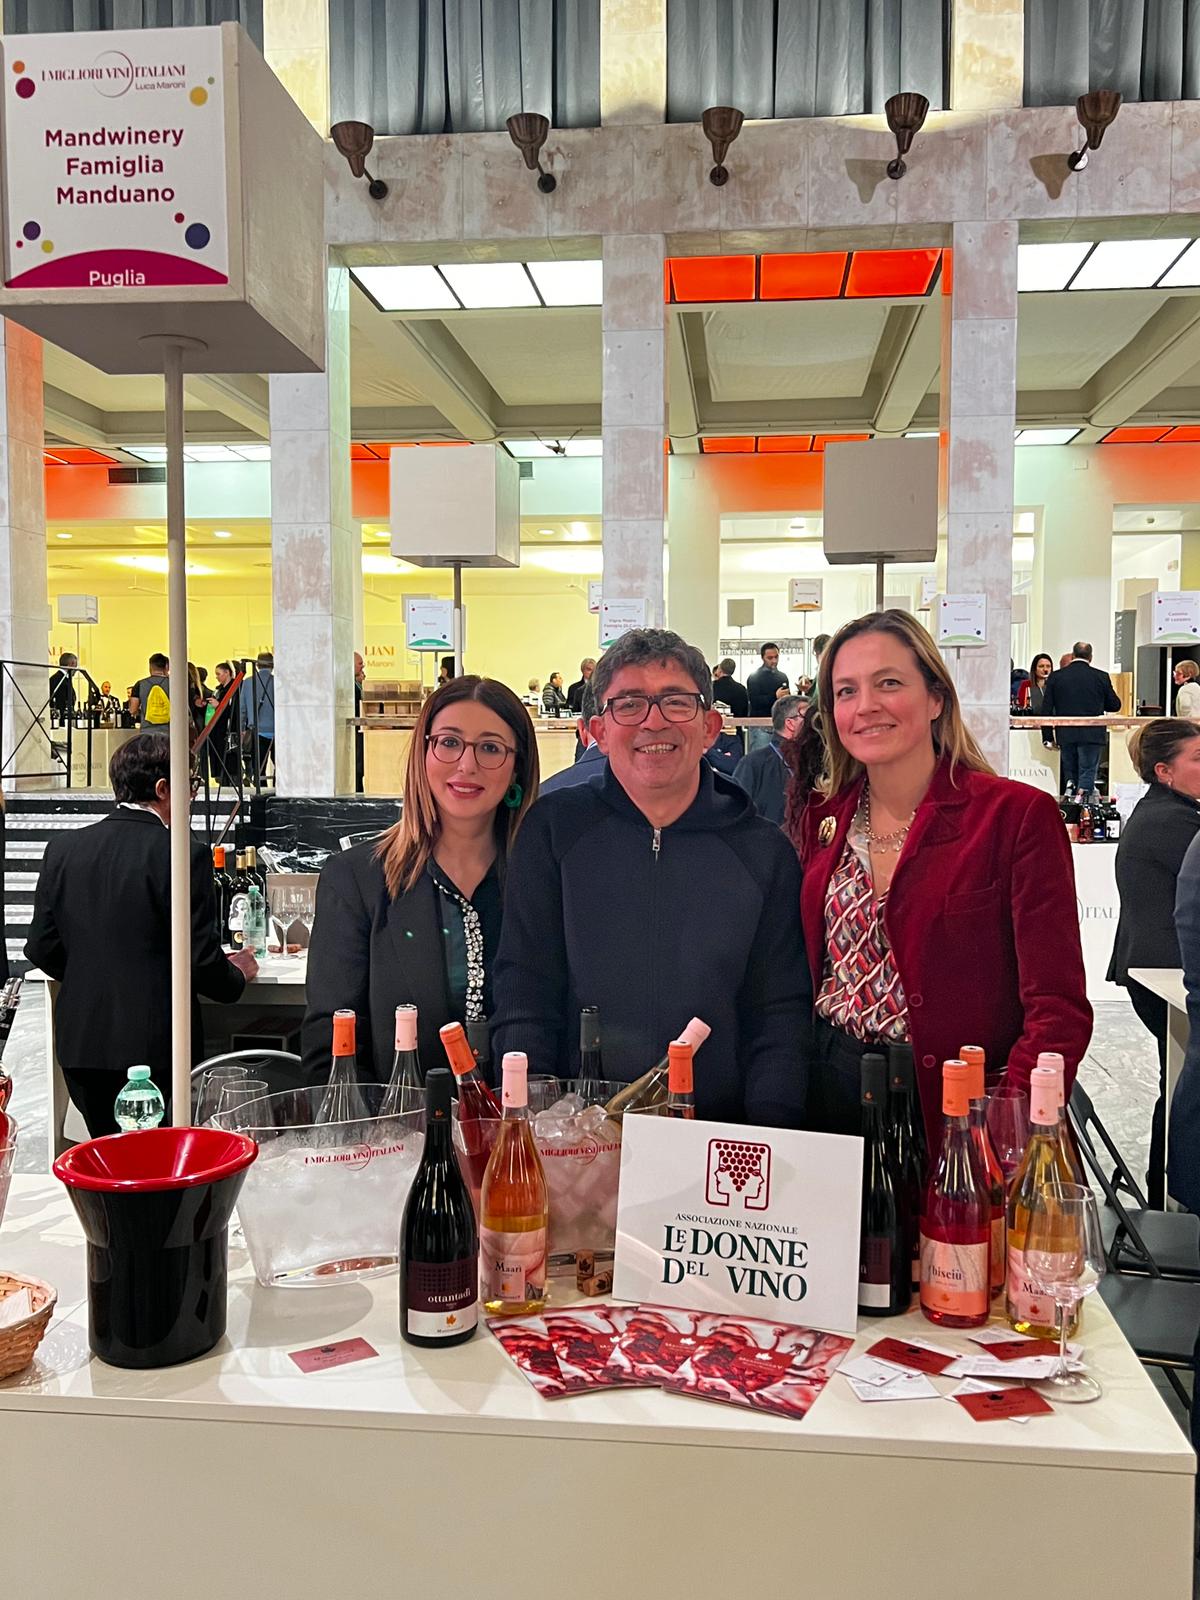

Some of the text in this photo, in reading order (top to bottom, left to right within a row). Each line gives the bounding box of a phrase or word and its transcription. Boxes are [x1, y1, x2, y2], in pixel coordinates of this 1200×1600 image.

[48, 68, 103, 81] MIGLIORI
[105, 67, 130, 79] VINI
[135, 64, 186, 78] ITALIANI
[135, 81, 186, 90] Luca Maroni
[45, 126, 184, 147] Mandwinery
[66, 155, 164, 178] Famiglia
[57, 184, 175, 204] Manduano
[89, 269, 146, 287] Puglia
[310, 1153, 351, 1164] MIGLIORI
[352, 1150, 369, 1160] VINI
[371, 1143, 404, 1158] ITALIANI
[675, 1213, 799, 1235] ASSOCIAZIONE NAZIONALE
[689, 1227, 809, 1269] DONNE
[725, 1265, 808, 1302] VINO
